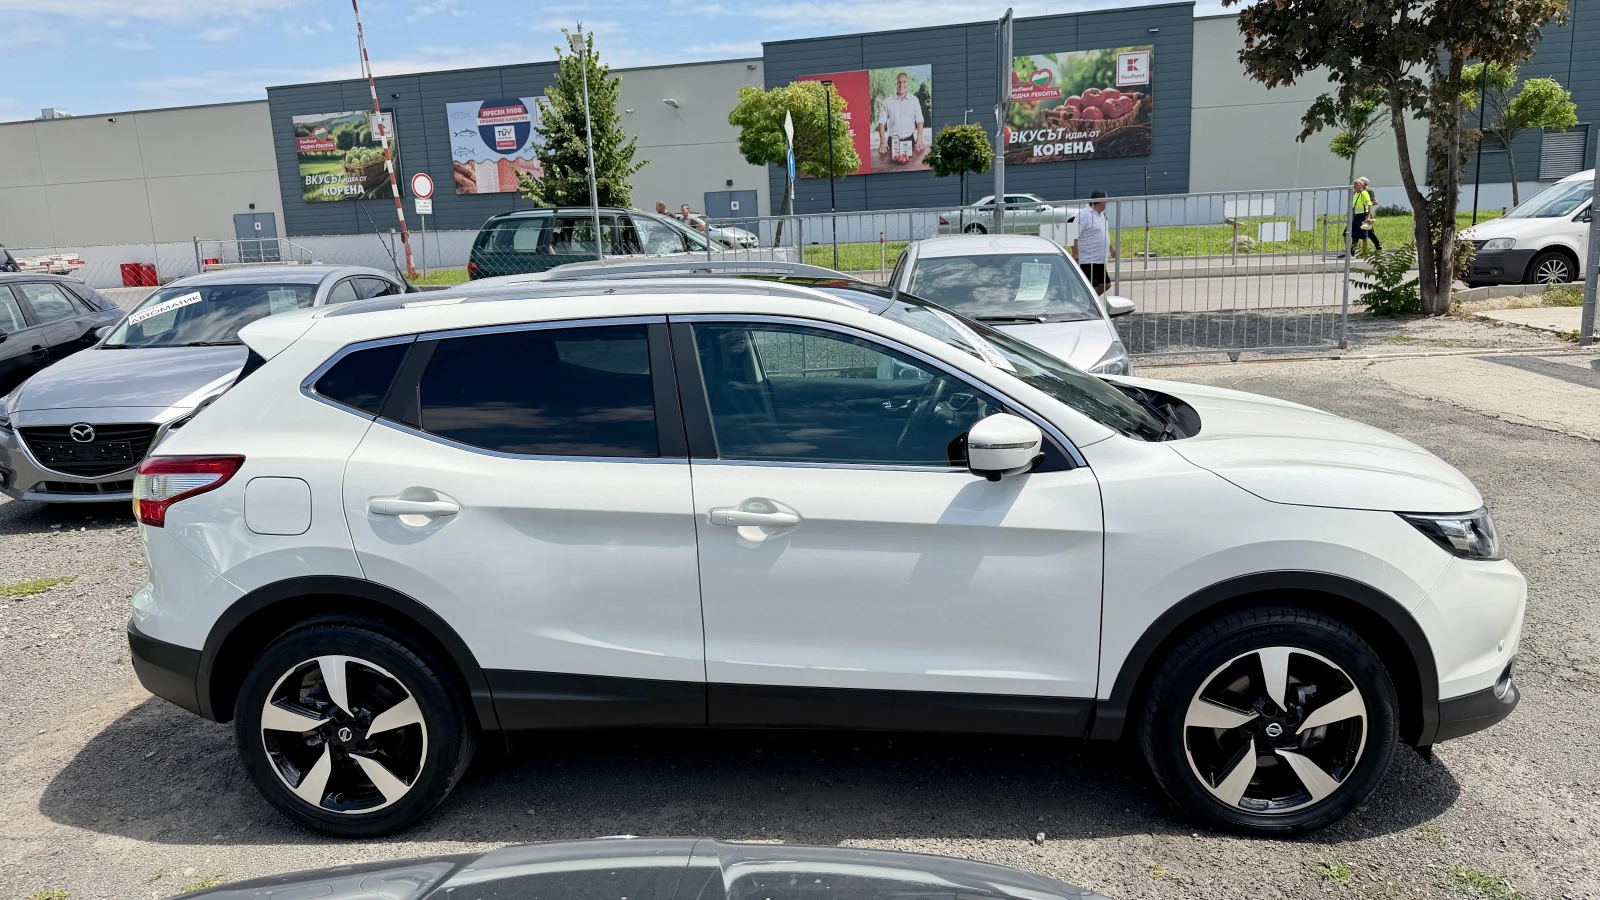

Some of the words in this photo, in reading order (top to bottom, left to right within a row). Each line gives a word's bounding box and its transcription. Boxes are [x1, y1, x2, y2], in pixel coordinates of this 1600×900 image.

[1011, 85, 1034, 93] aufland
[1010, 128, 1066, 143] ВКУСЪТ
[1065, 131, 1087, 139] ИДВА
[1089, 130, 1101, 138] ОТ
[1033, 142, 1094, 156] КОРЕНА
[306, 174, 343, 185] ВКУСЪТ
[323, 185, 364, 196] КОРЕНА
[131, 294, 200, 324] АВТОМАТИК
